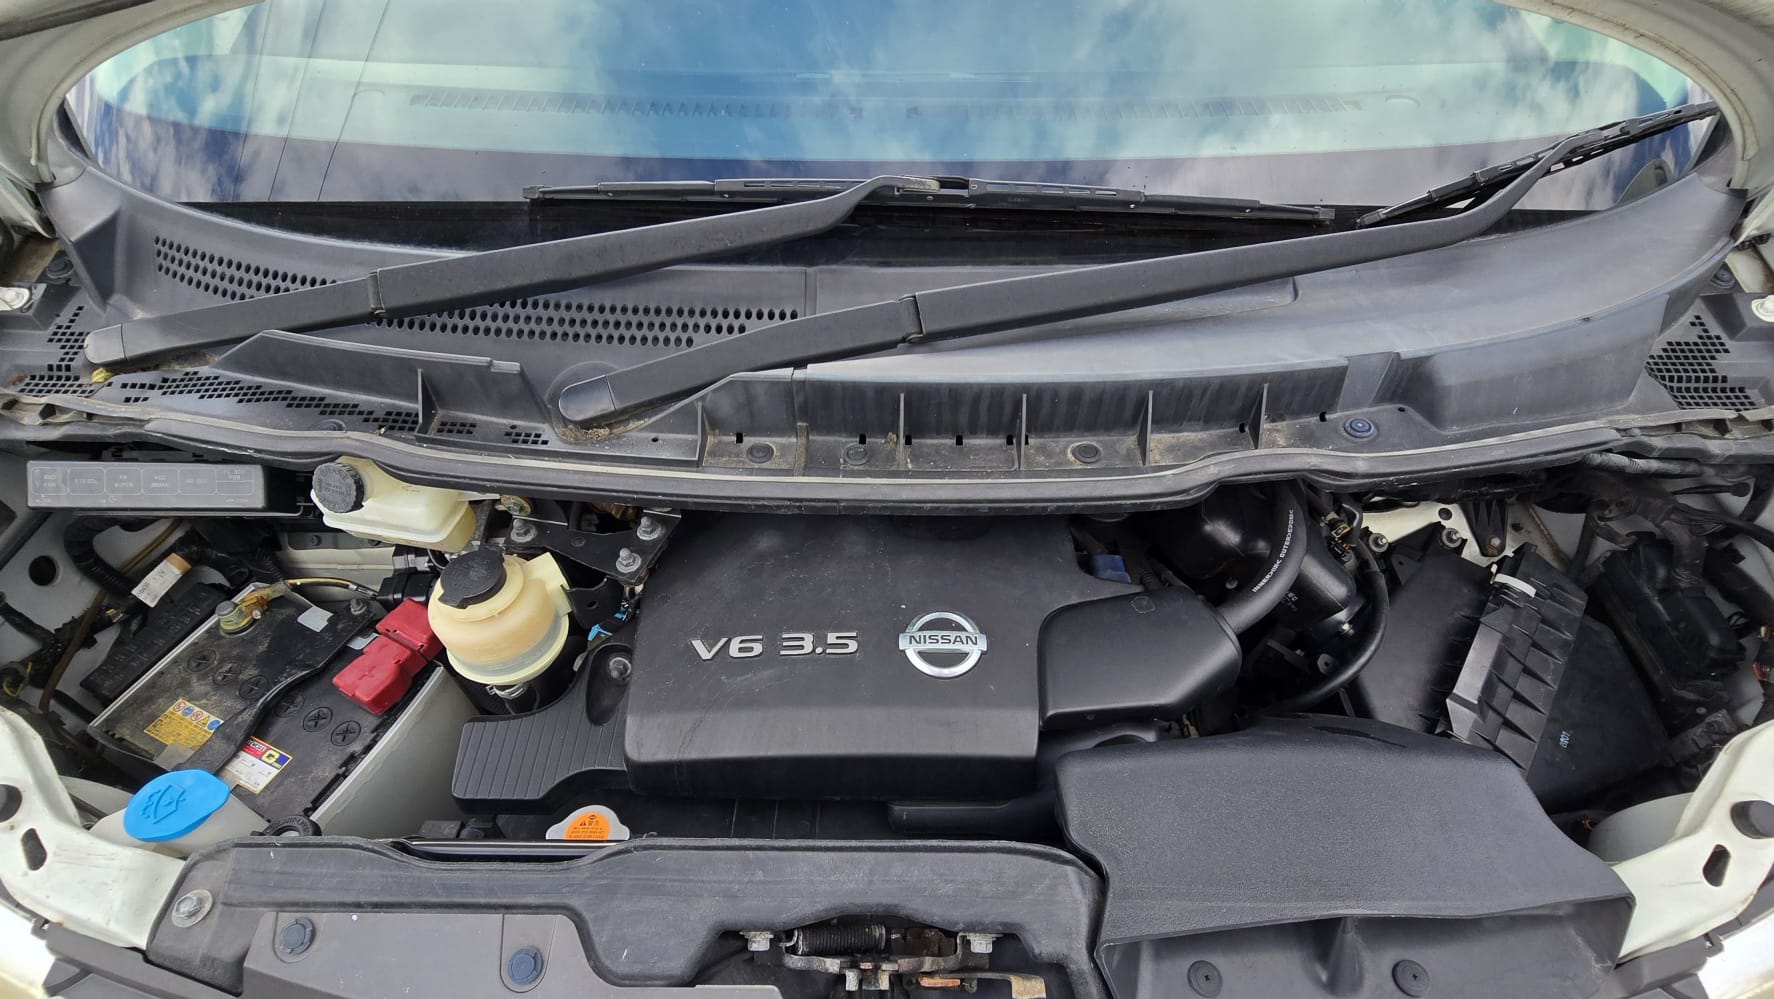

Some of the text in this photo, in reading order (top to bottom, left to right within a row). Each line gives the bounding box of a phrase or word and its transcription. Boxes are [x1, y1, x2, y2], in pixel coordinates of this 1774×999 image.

[690, 631, 859, 661] V6 3.5
[907, 633, 979, 647] NISSAN
